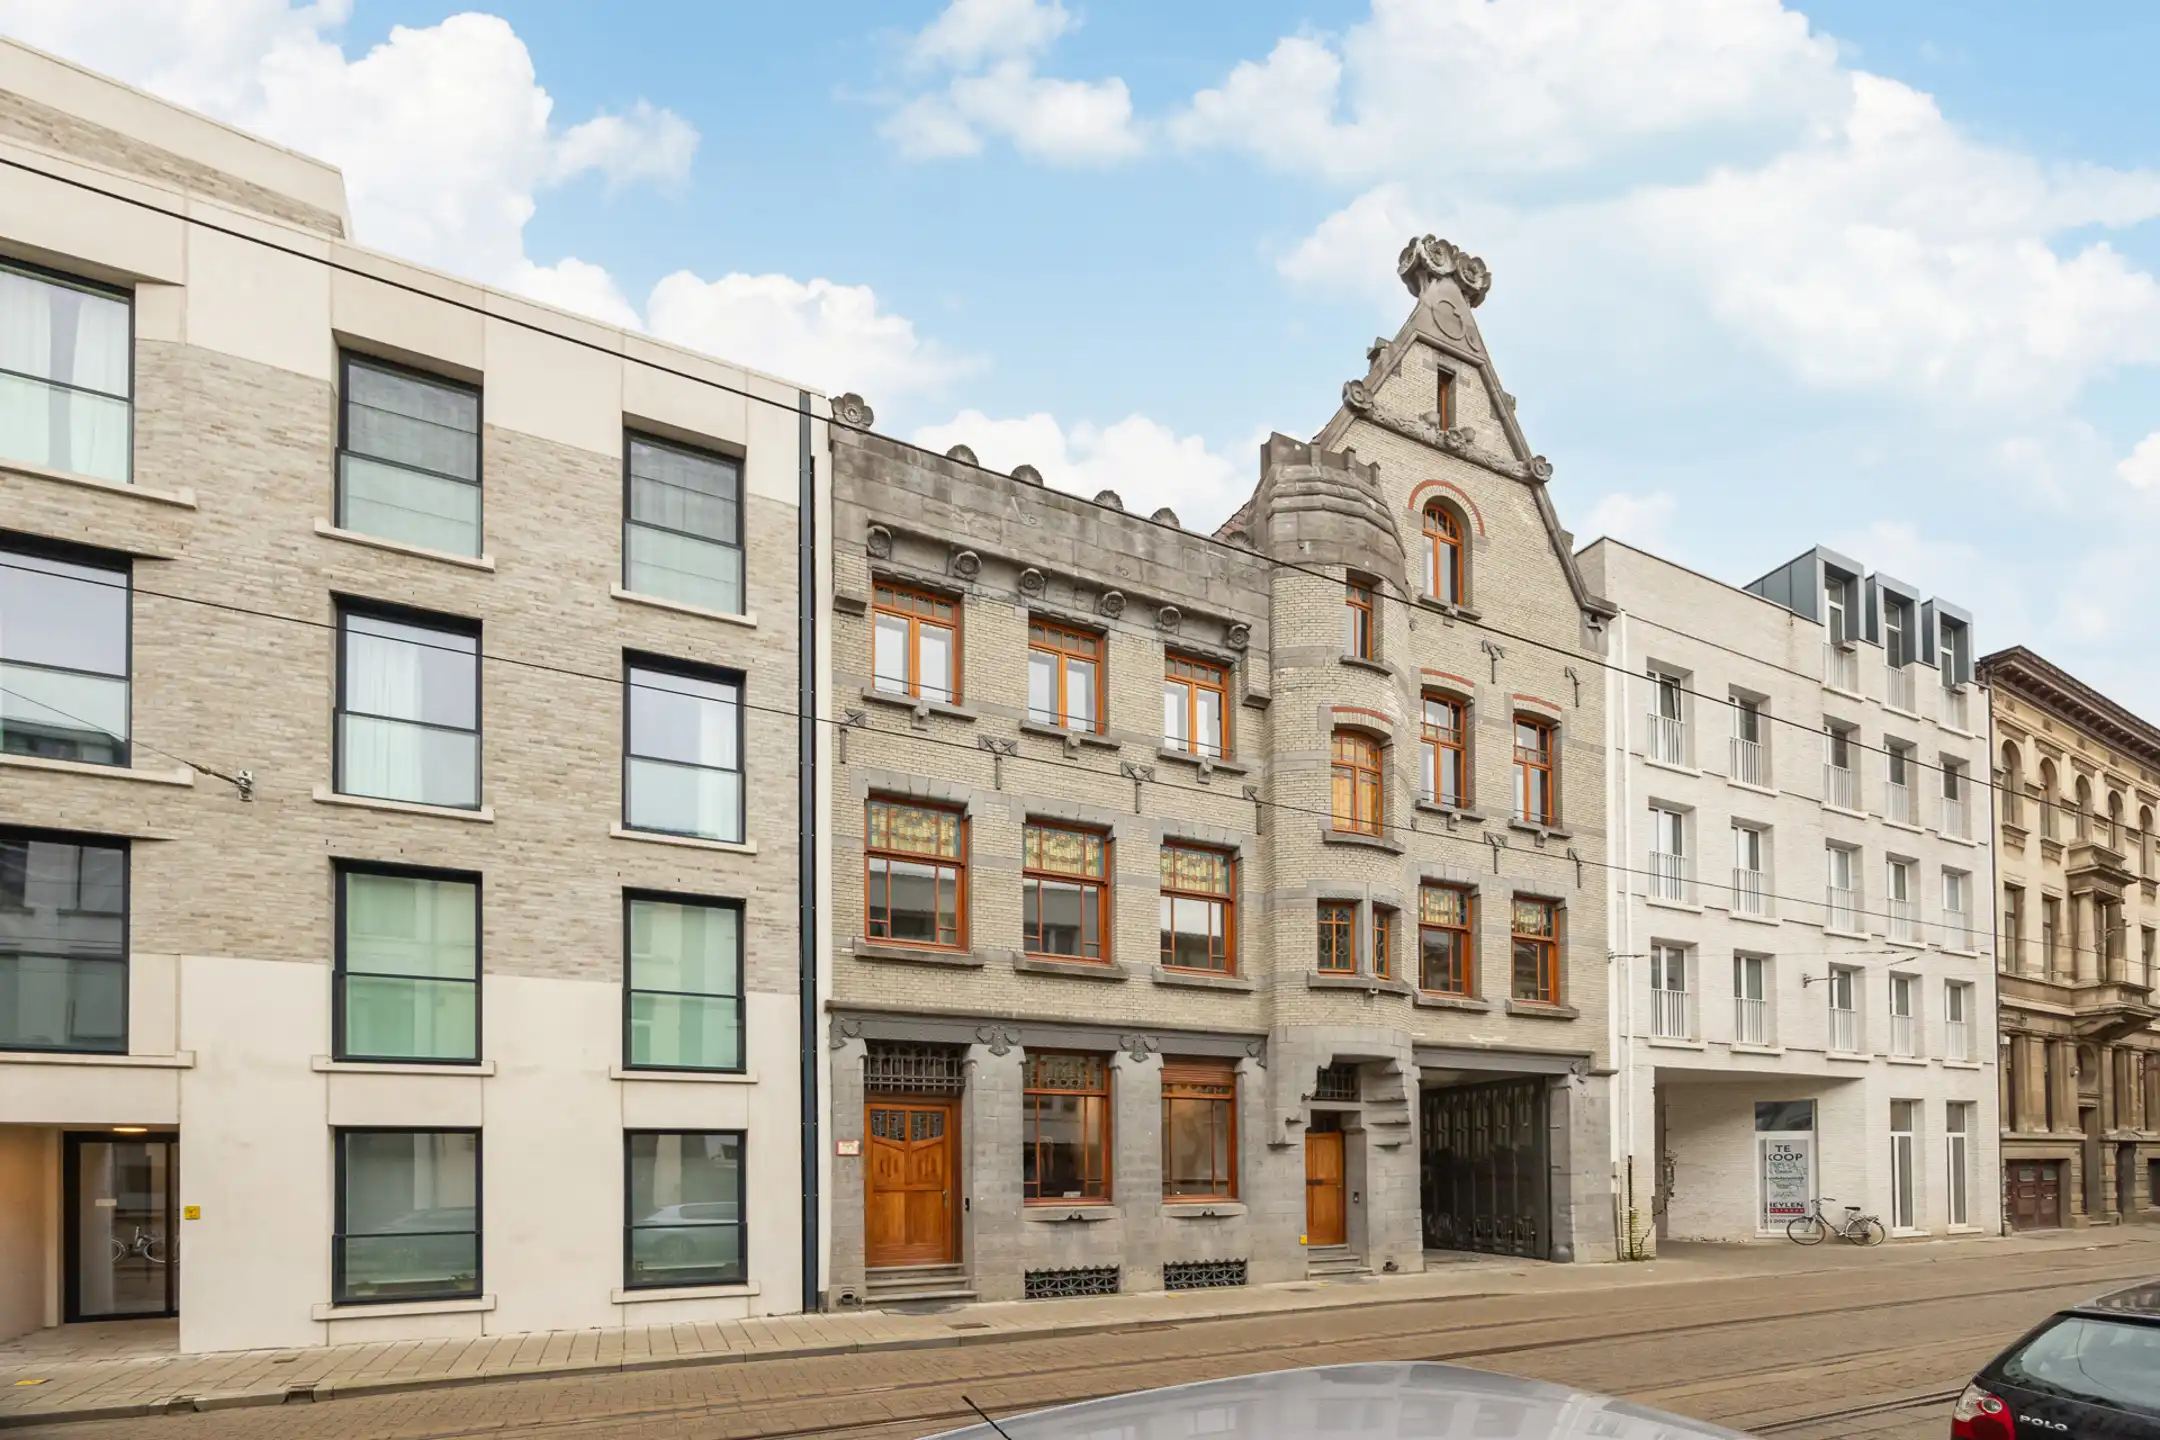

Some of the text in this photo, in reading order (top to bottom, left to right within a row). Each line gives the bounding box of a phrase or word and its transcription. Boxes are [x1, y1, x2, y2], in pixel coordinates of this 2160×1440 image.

[1775, 1144, 1791, 1152] TE
[1764, 1153, 1803, 1161] KOOP
[2019, 1414, 2068, 1431] POLO
